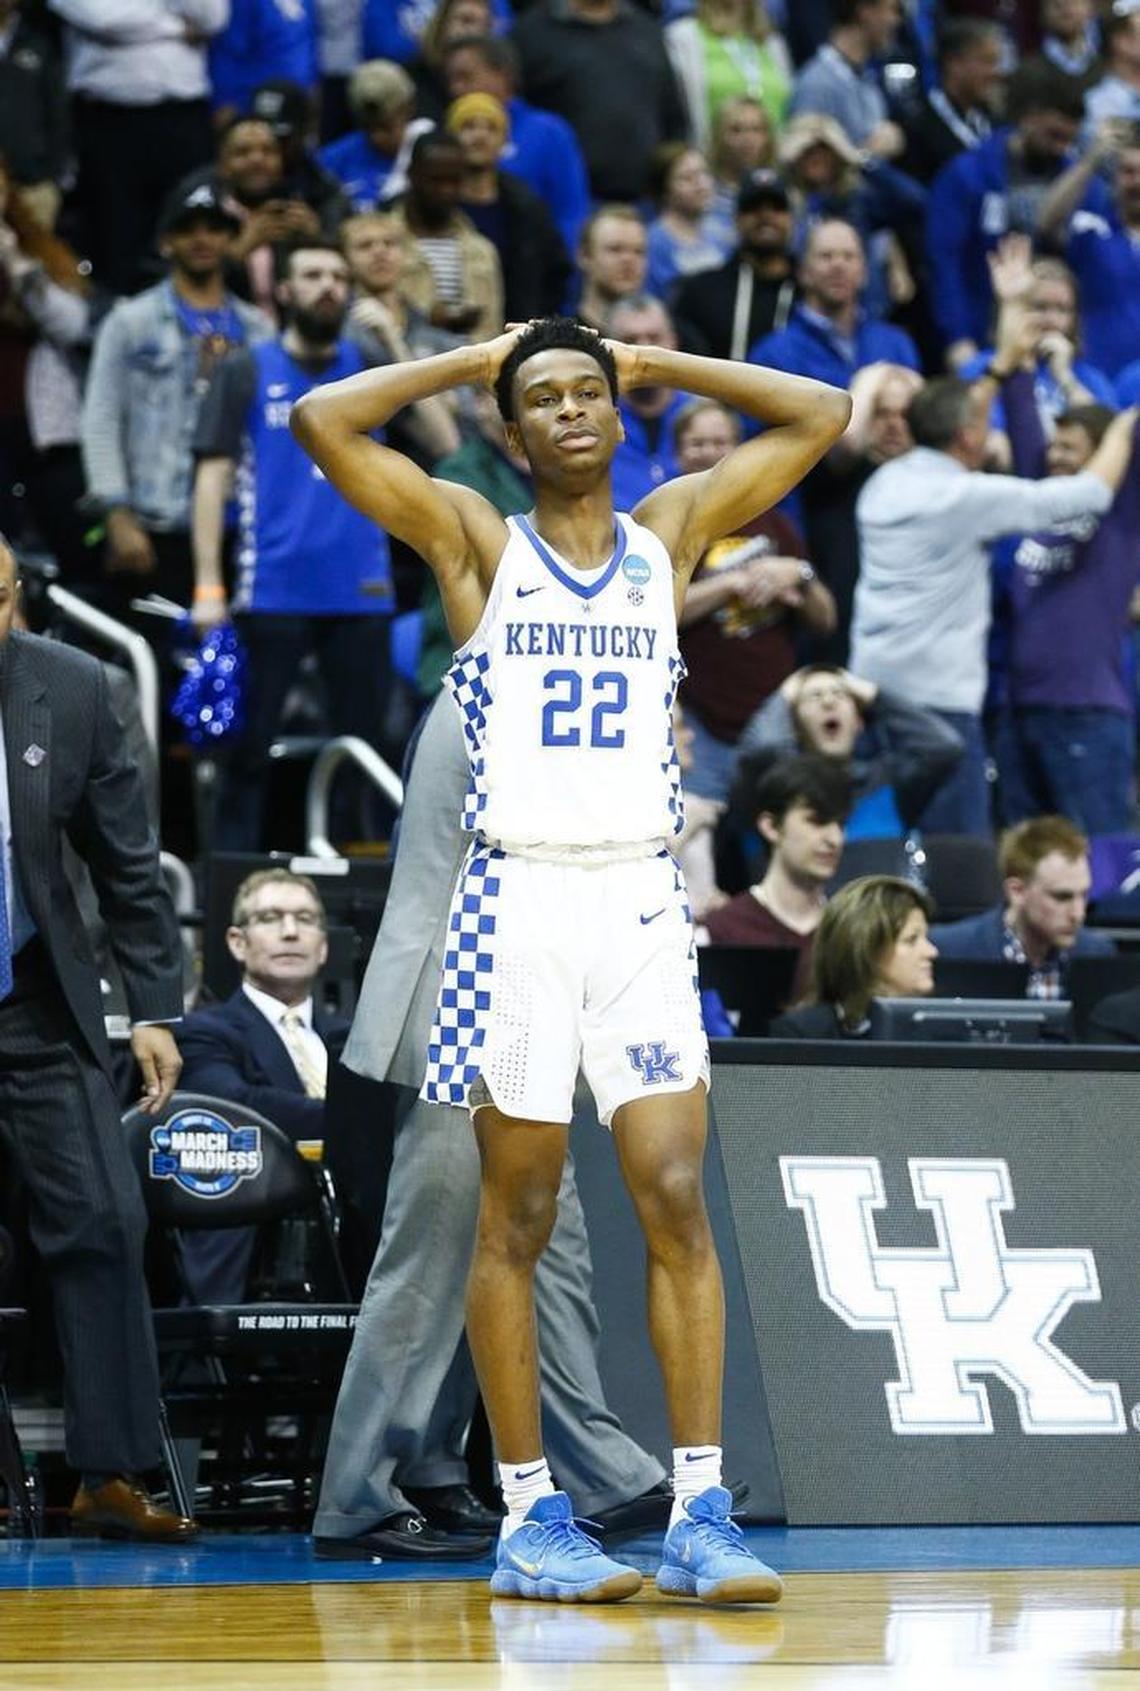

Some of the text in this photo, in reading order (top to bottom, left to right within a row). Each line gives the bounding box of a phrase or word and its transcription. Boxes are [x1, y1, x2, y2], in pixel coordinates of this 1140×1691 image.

[505, 623, 657, 660] KENTUCKY
[542, 670, 628, 748] 22
[626, 1040, 683, 1085] UK
[171, 1131, 228, 1150] MARCH
[180, 1150, 259, 1169] MADNESS
[779, 1156, 1127, 1435] UK
[238, 1316, 257, 1329] THE
[258, 1316, 285, 1329] ROAD
[286, 1316, 300, 1329] TO
[300, 1316, 320, 1329] THE
[320, 1316, 347, 1328] FINAL
